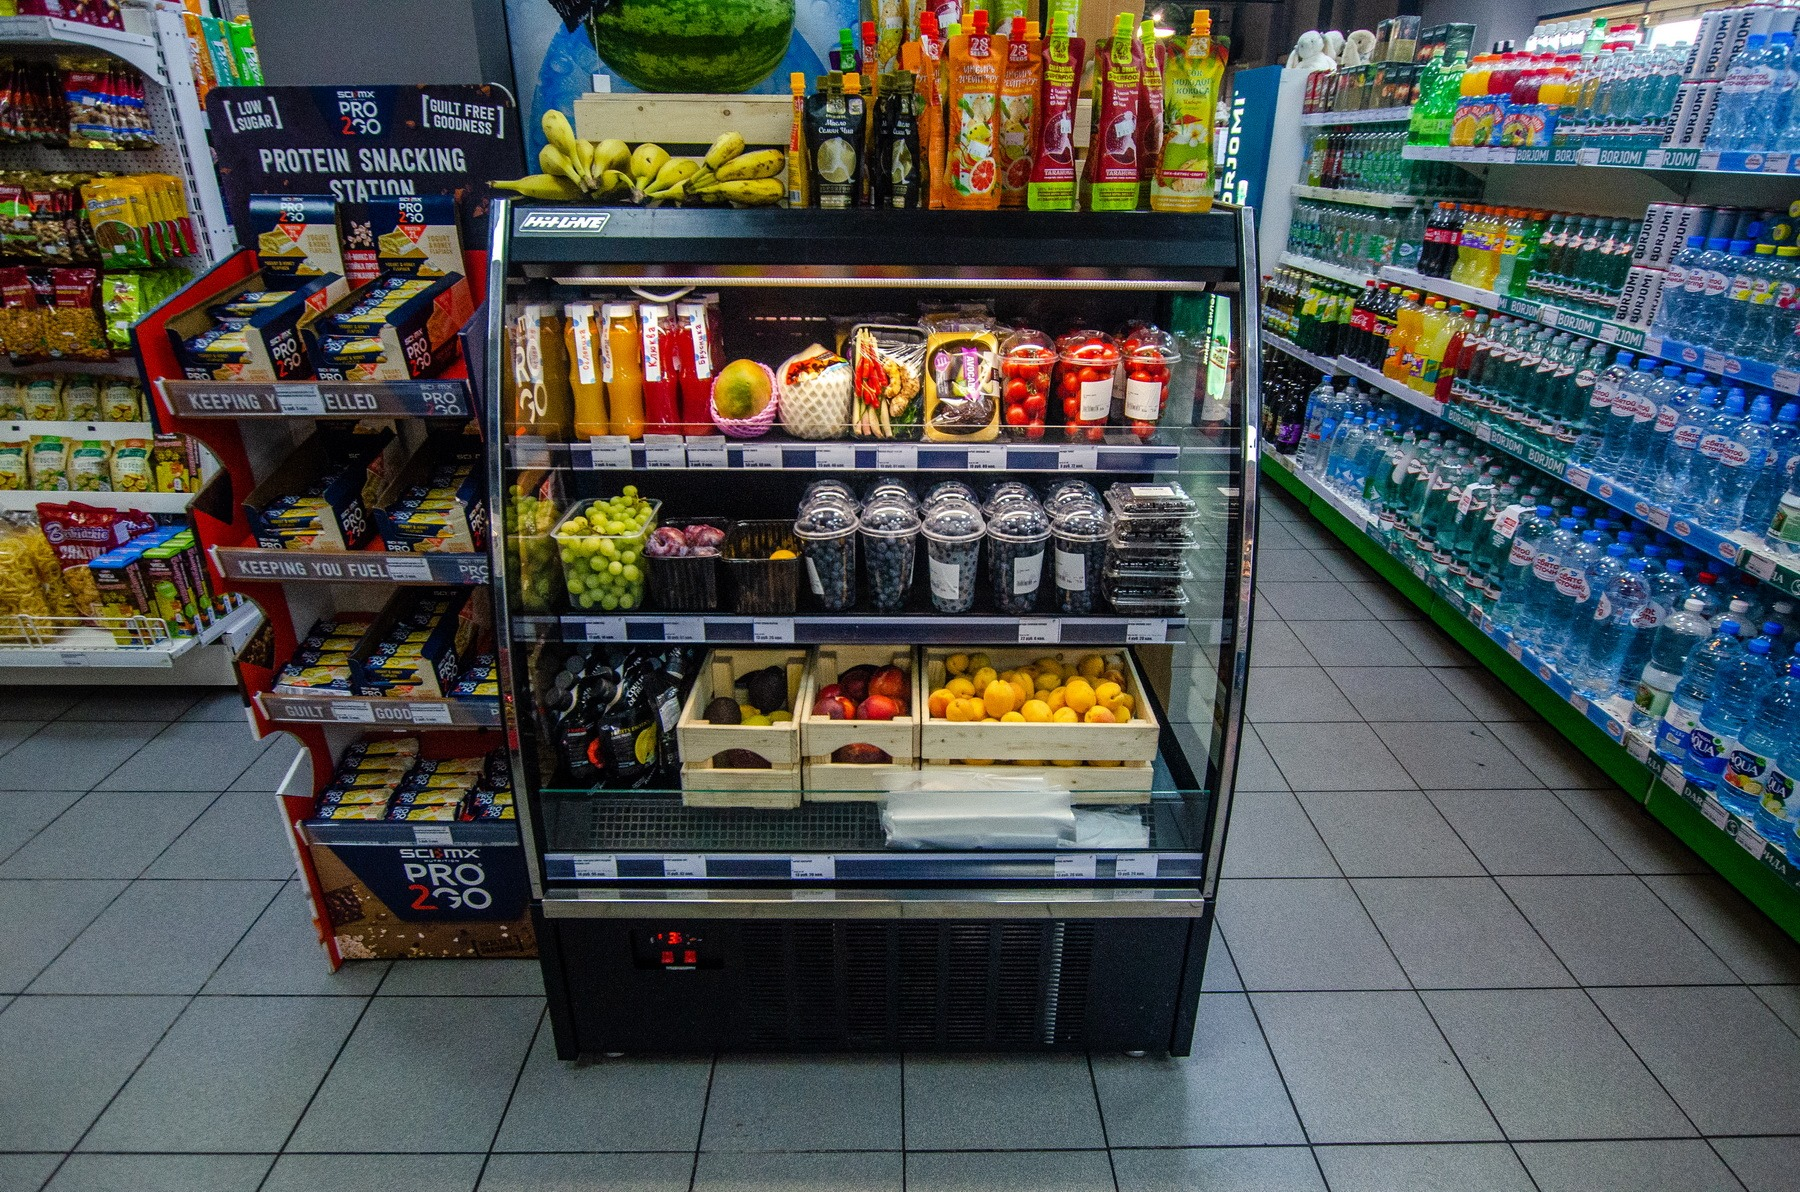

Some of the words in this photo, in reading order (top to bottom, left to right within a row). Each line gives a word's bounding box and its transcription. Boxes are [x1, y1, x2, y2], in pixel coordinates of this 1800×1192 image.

[970, 37, 990, 52] 28
[1009, 43, 1029, 57] 28
[1705, 15, 1733, 73] BORJOMI
[238, 100, 263, 115] LOW
[339, 101, 378, 118] PRO
[430, 98, 461, 117] GUILT
[464, 103, 496, 121] FREE
[1662, 89, 1688, 144] BORJOMI
[1681, 88, 1707, 144] BORJOMI
[237, 114, 274, 132] SUGAR
[340, 116, 381, 135] 2GO
[433, 112, 493, 135] GOODNESS
[1222, 97, 1247, 205] ORJOMI
[1516, 149, 1550, 161] BORJOMI
[1554, 149, 1582, 162] BORJO
[1600, 151, 1643, 165] BORJOMI
[1662, 152, 1698, 167] RJOMI
[259, 148, 351, 173] PROTEIN
[358, 148, 467, 174] SNACKING
[329, 179, 416, 203] STATION
[280, 202, 304, 212] PRO
[398, 202, 423, 213] PRO
[279, 211, 305, 223] 2GO
[398, 211, 424, 223] 2GO
[1634, 209, 1657, 260] BORJOMI
[1650, 211, 1674, 262] BORJOMI
[1616, 272, 1640, 321] BORJOMI
[1629, 274, 1654, 324] BORJOMI
[1557, 314, 1596, 334] BORJOMI
[272, 338, 297, 360] PRO
[406, 337, 428, 360] PRO
[646, 325, 659, 368] Клюква
[696, 323, 707, 366] Брусника
[188, 393, 259, 411] KEEPING
[327, 394, 377, 411] ELLED
[423, 391, 457, 405] PRO
[1491, 429, 1524, 455] BORJOMI
[1679, 430, 1700, 439] свято
[1528, 448, 1565, 475] BORJOMI
[238, 559, 307, 577] KEEPING
[311, 563, 343, 577] YOU
[1536, 558, 1560, 570] свято
[1559, 572, 1584, 585] свято
[285, 705, 325, 719] GUILT
[403, 863, 486, 886] PRO
[408, 884, 493, 910] 2GO
